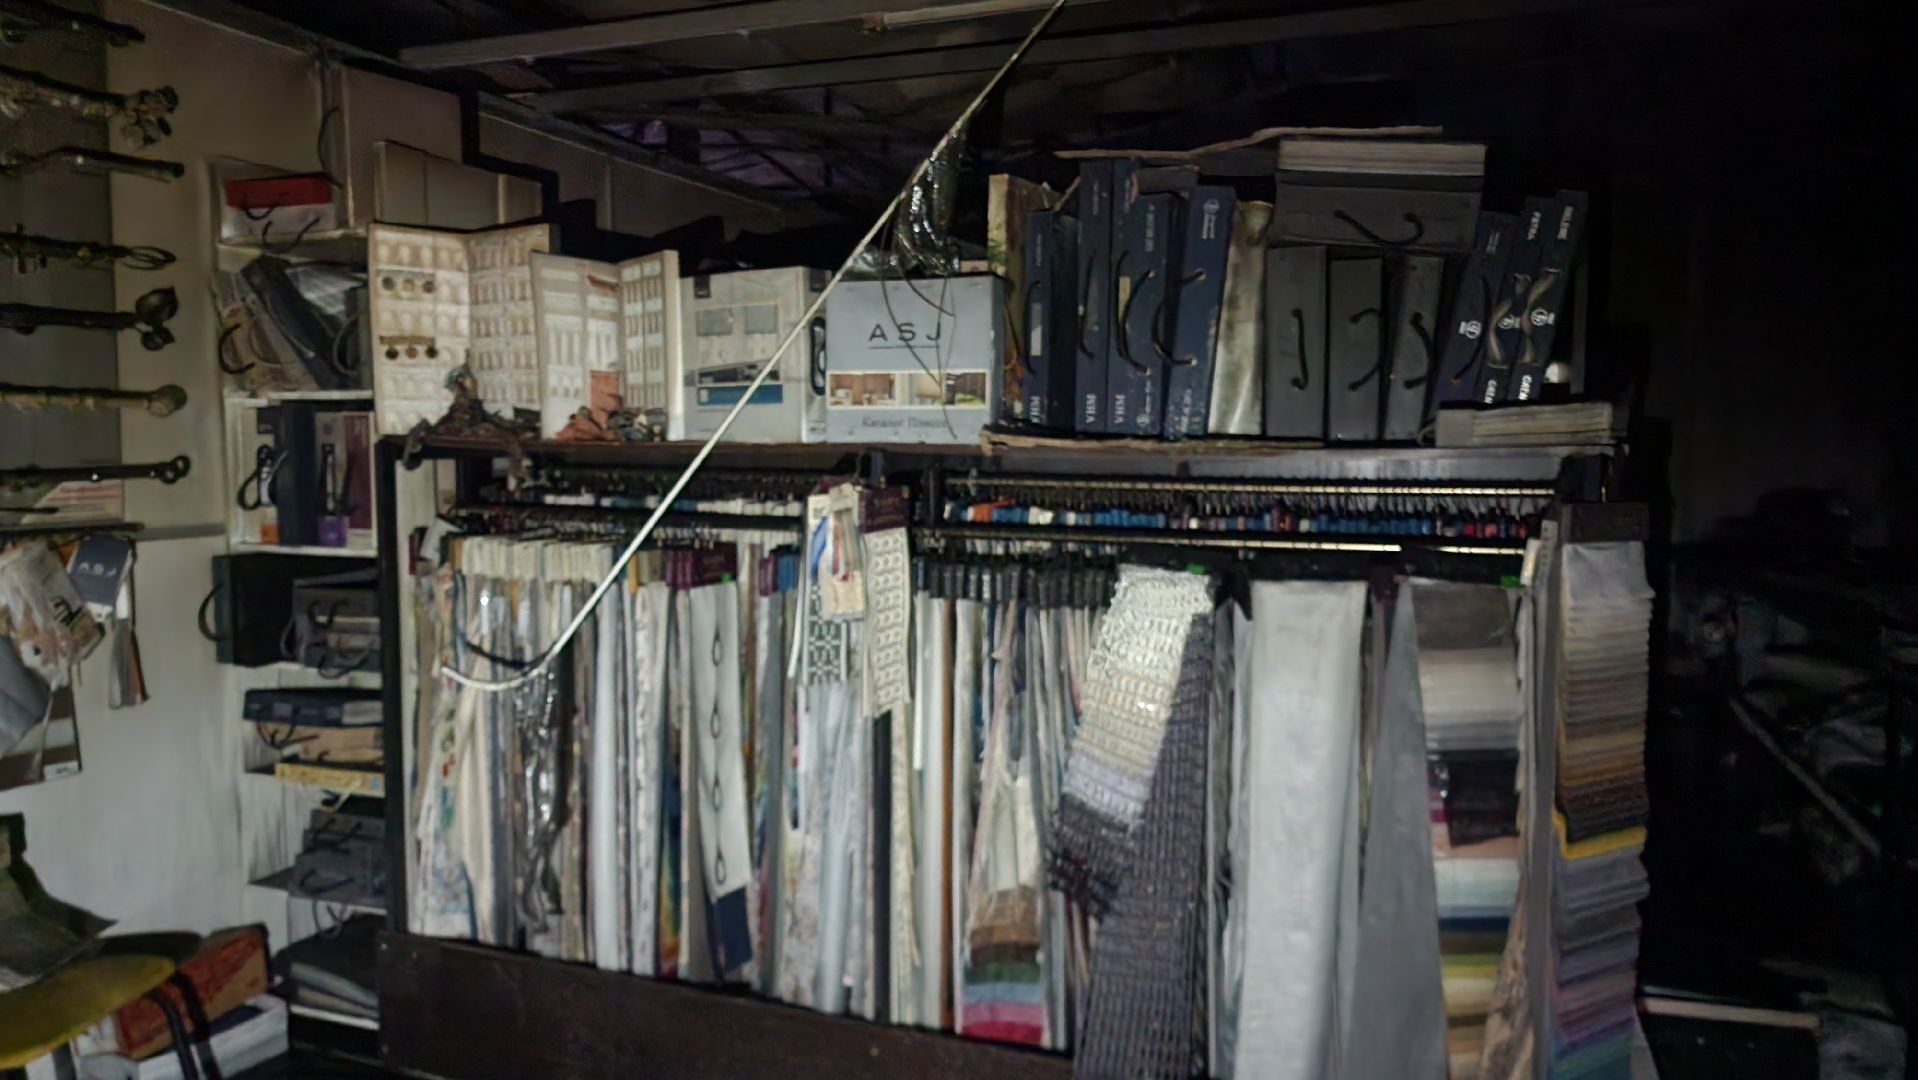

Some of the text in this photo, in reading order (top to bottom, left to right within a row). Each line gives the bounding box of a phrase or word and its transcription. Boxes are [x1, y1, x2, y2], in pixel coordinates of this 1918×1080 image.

[869, 322, 941, 342] ASJ
[1086, 394, 1096, 423] VHM
[1114, 394, 1125, 424] VHM
